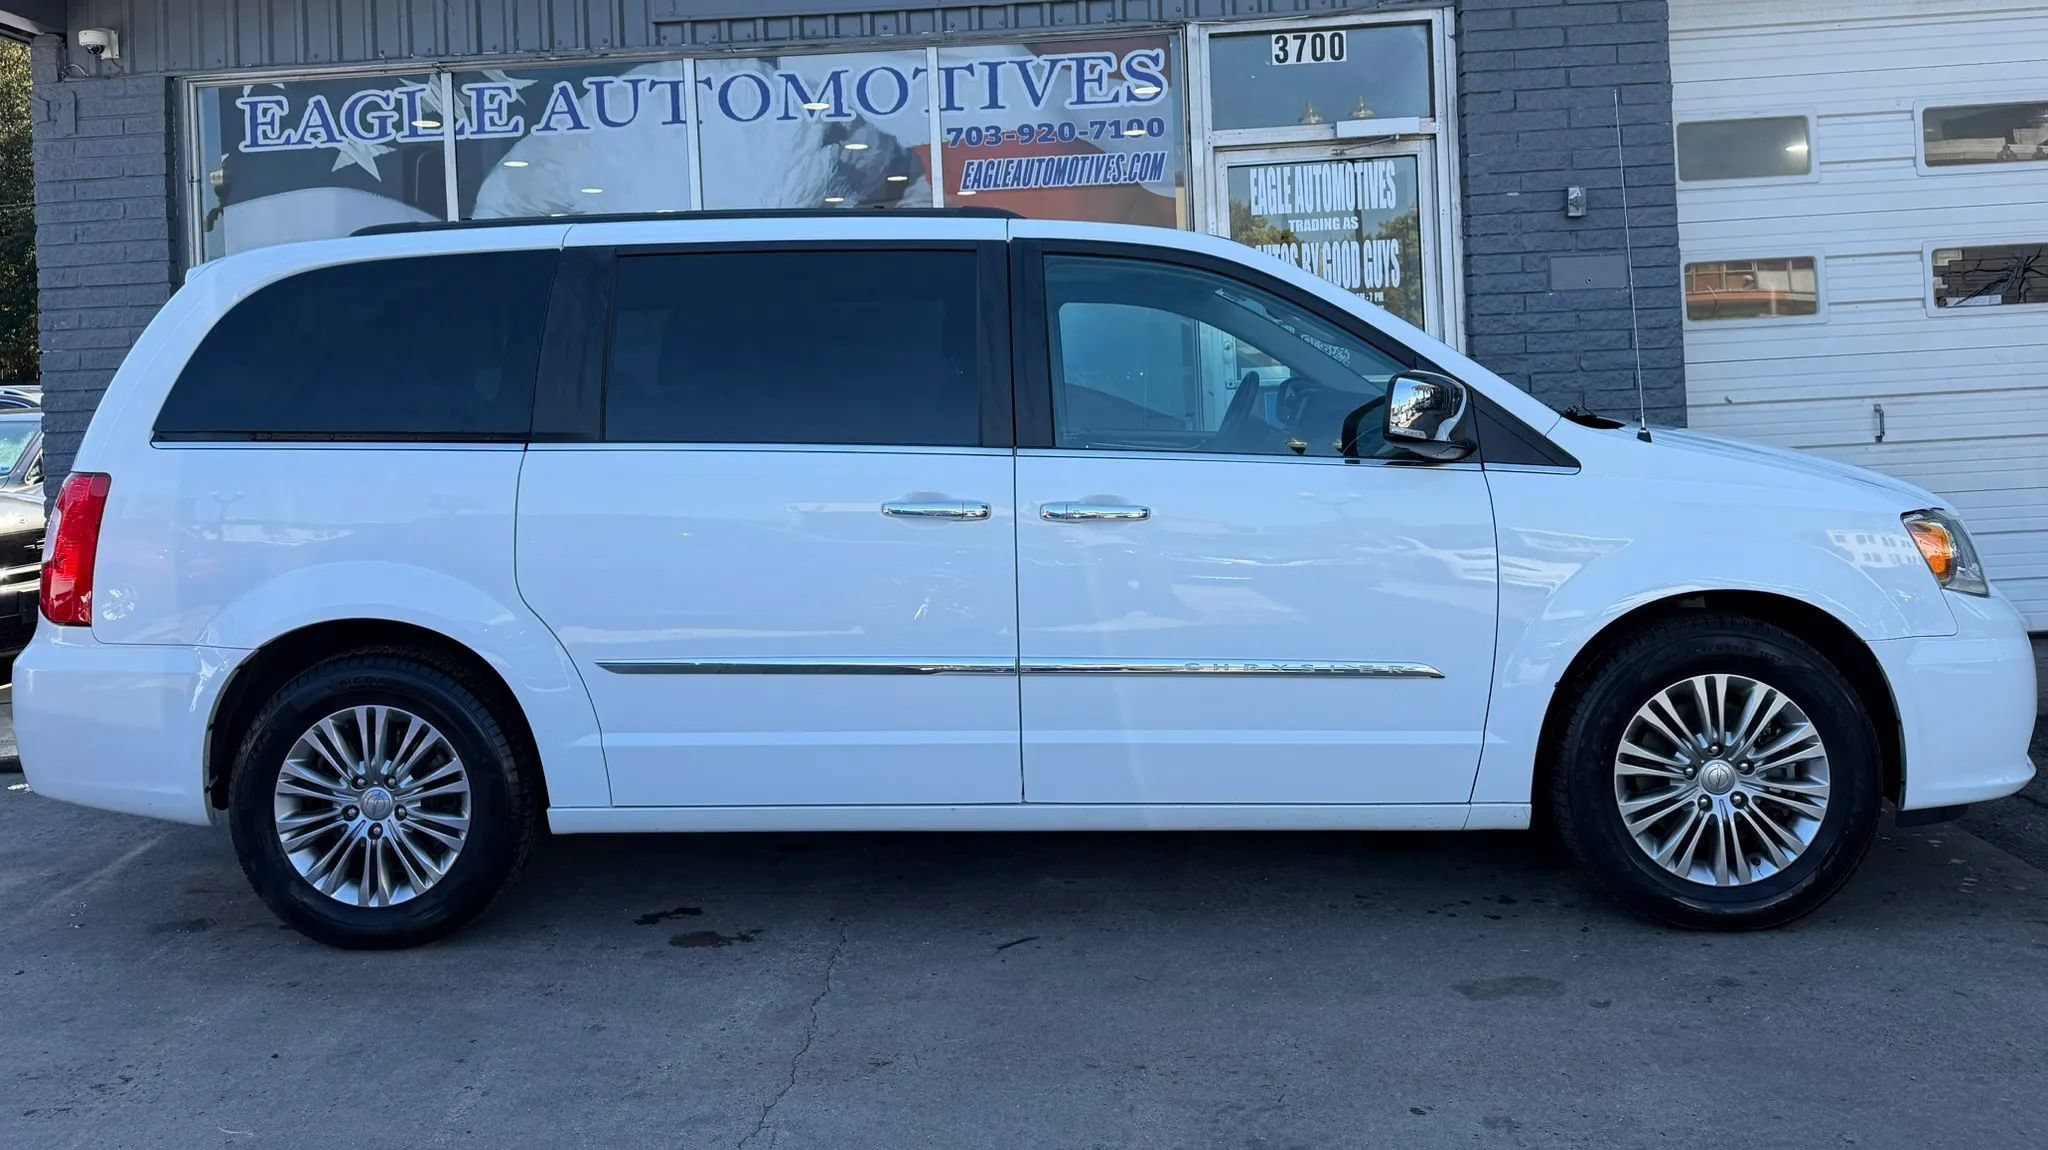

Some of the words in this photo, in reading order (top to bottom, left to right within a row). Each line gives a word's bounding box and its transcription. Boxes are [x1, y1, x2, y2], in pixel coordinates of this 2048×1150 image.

[1273, 31, 1345, 63] 3700
[239, 83, 522, 150] EAGLE
[534, 51, 1164, 134] AUTOMOTIVES
[947, 118, 1165, 148] 703-920-7100
[961, 152, 1168, 191] EAGLEAUTOMOTIVES.COM
[1250, 166, 1292, 216] EAGLE
[1294, 160, 1396, 213] AUTOMOTIVES
[1288, 218, 1341, 233] TRADING
[1342, 216, 1359, 230] AS
[1323, 240, 1361, 289] GOOD
[1363, 238, 1400, 289] GUYS
[1374, 291, 1384, 302] PM
[1184, 663, 1405, 674] CHRYSLER
